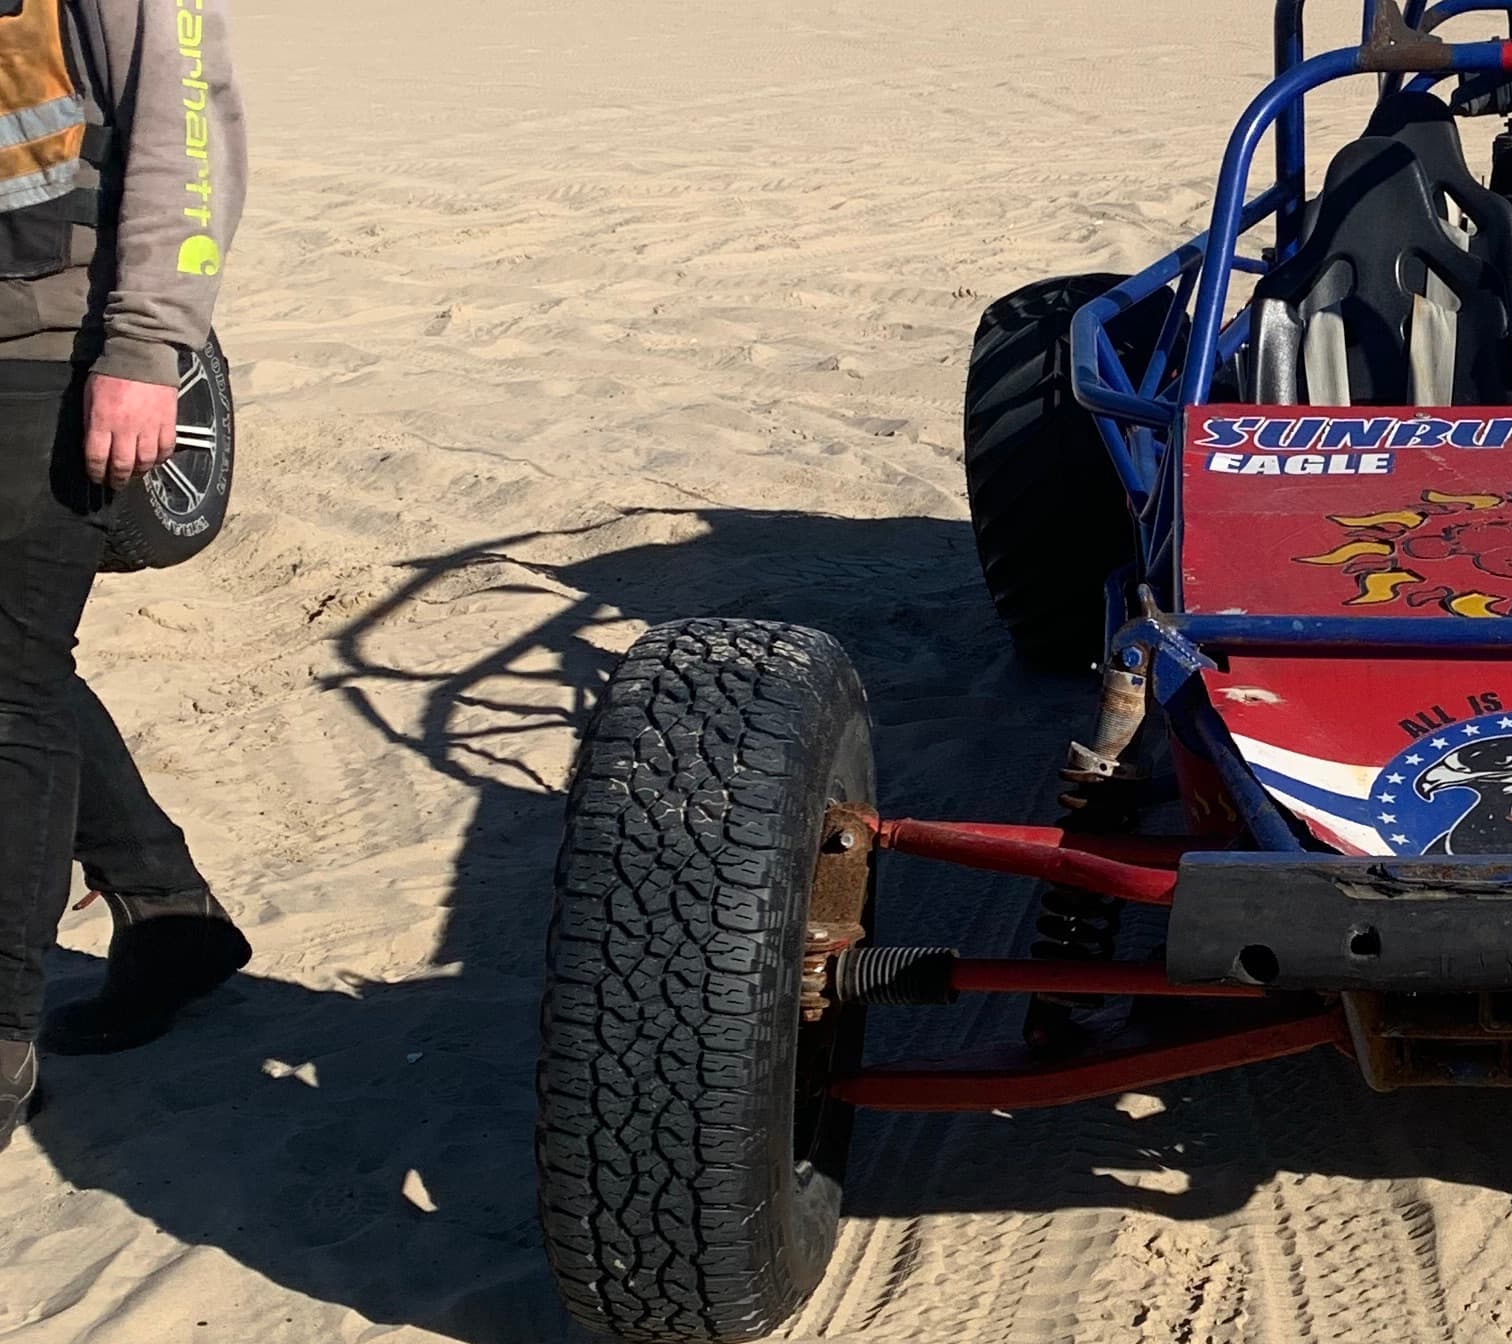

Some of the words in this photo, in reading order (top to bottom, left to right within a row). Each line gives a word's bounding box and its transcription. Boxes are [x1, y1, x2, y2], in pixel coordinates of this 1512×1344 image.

[203, 341, 231, 496] OODYEAR
[1208, 452, 1390, 475] EAGLE
[1398, 705, 1456, 739] ALL
[1466, 692, 1503, 716] IS
